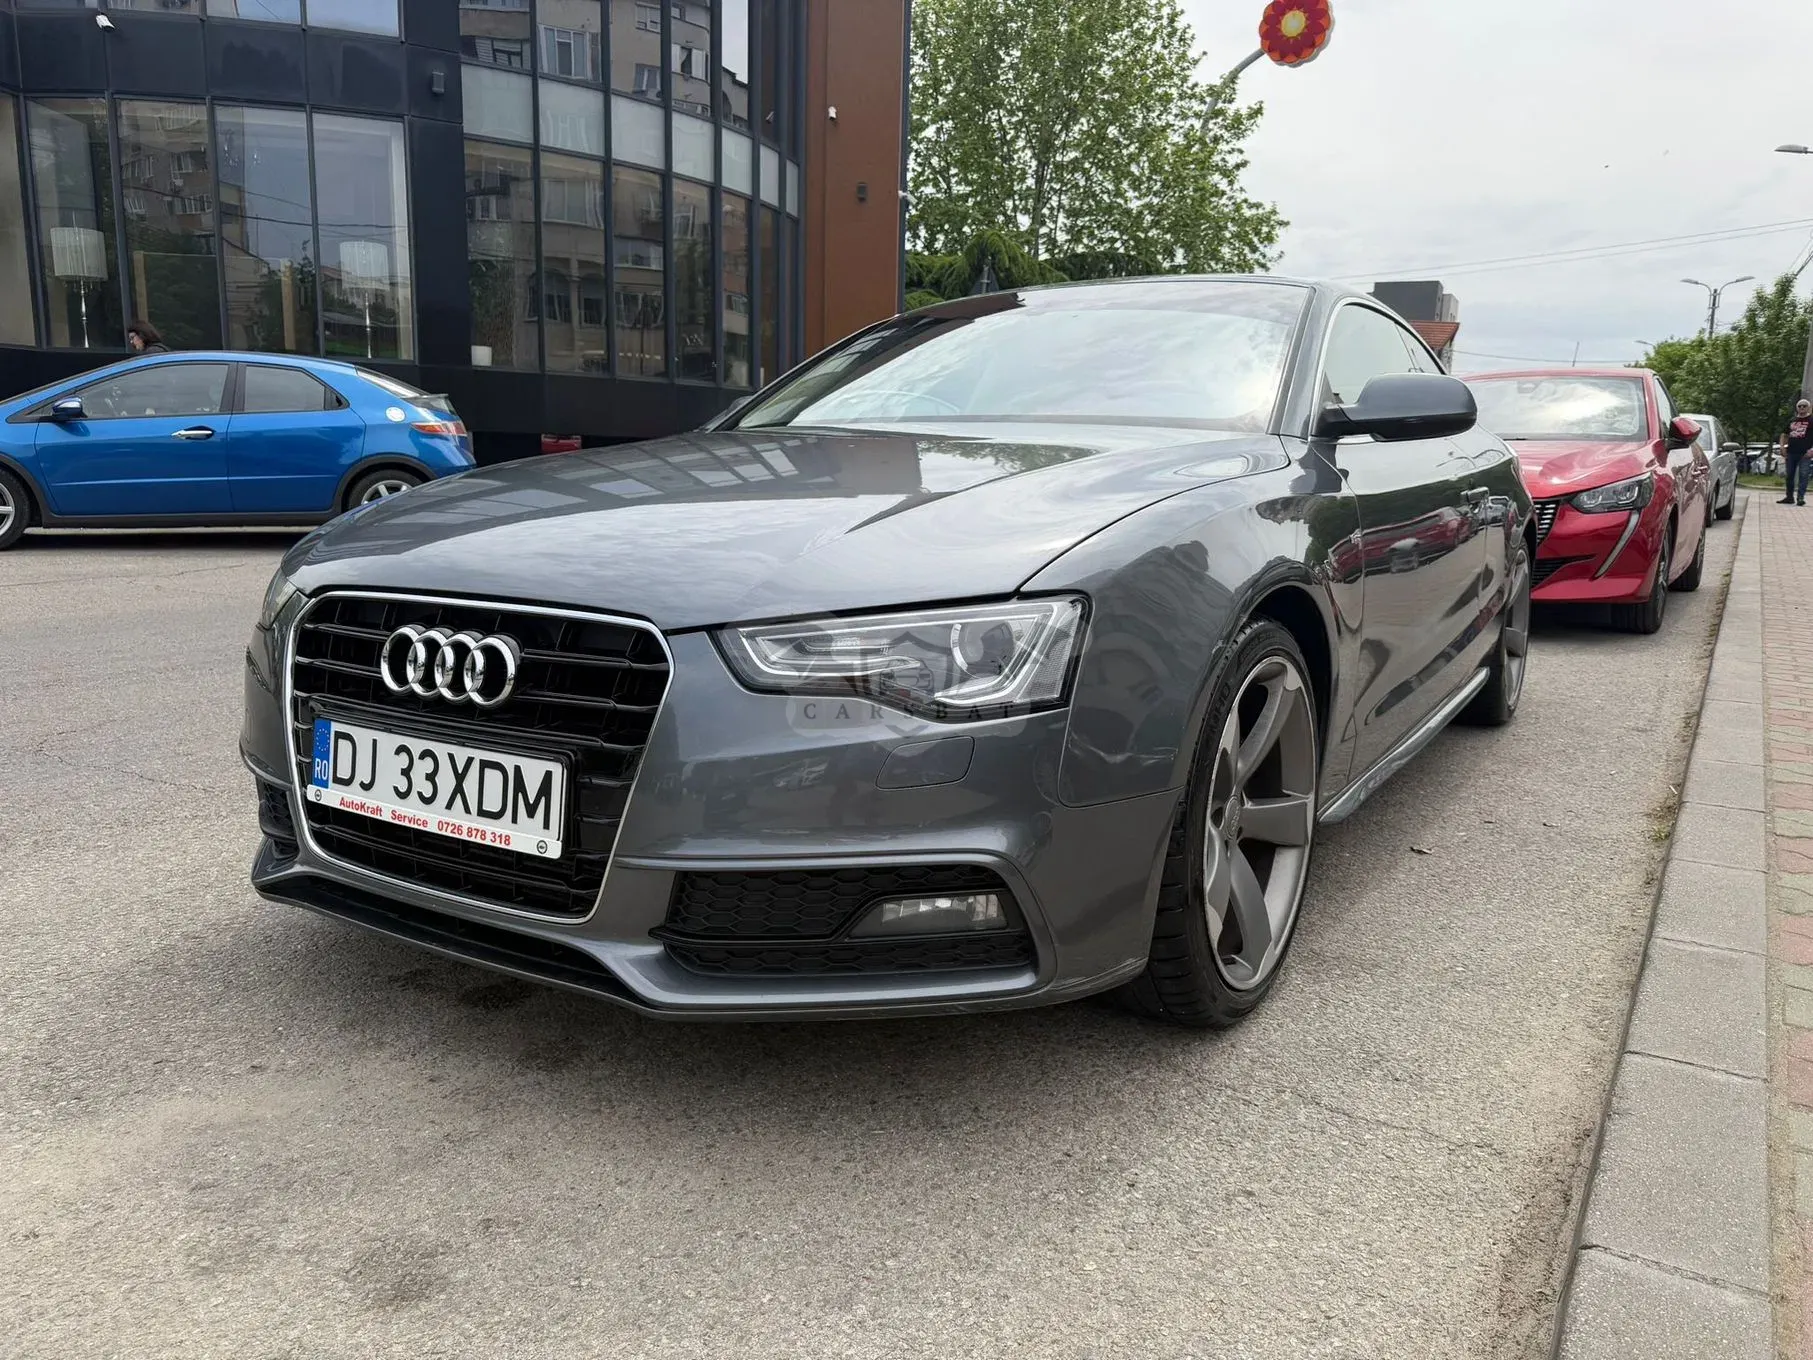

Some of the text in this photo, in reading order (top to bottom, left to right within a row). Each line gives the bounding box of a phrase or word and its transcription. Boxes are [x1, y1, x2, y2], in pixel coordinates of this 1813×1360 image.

[314, 758, 328, 781] RO
[332, 731, 378, 792] DJ
[339, 797, 511, 846] AutoKraft Service 0726 878 318
